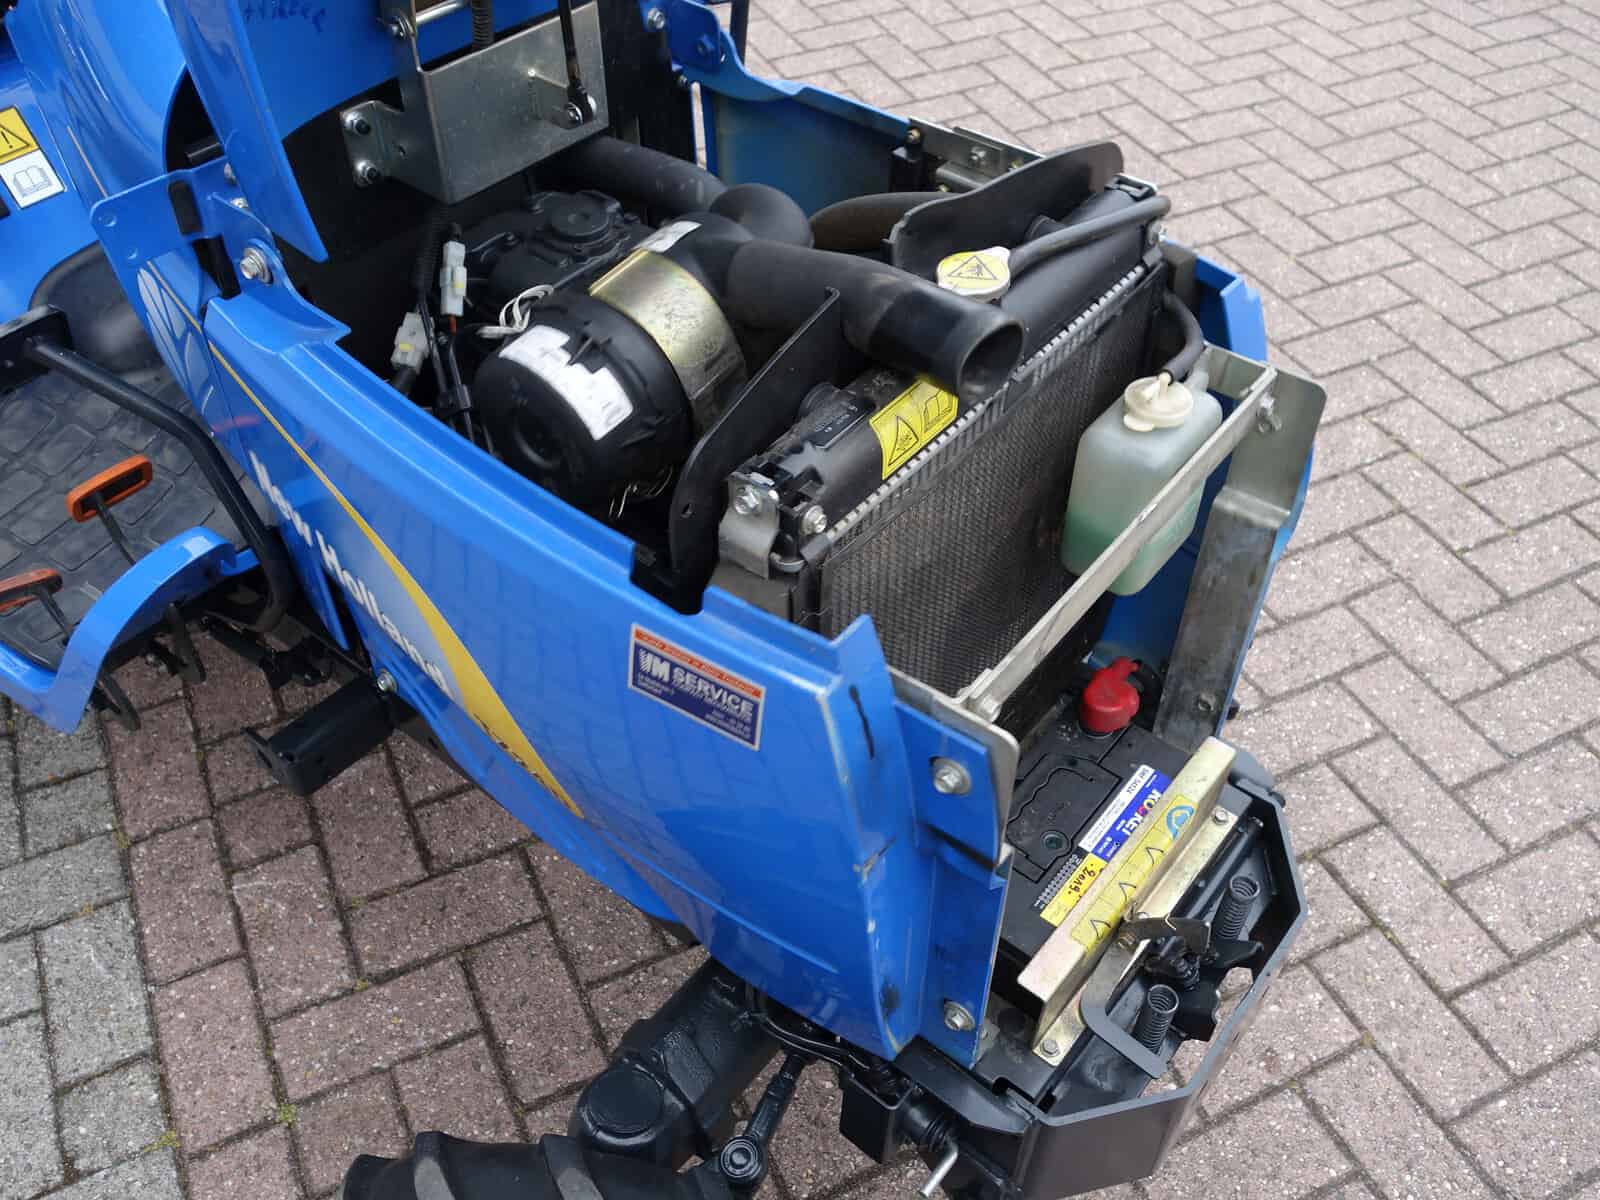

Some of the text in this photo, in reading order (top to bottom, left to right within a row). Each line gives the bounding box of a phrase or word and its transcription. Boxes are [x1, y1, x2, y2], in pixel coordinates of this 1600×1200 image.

[249, 450, 451, 696] New Holland
[672, 667, 753, 714] SERVICE
